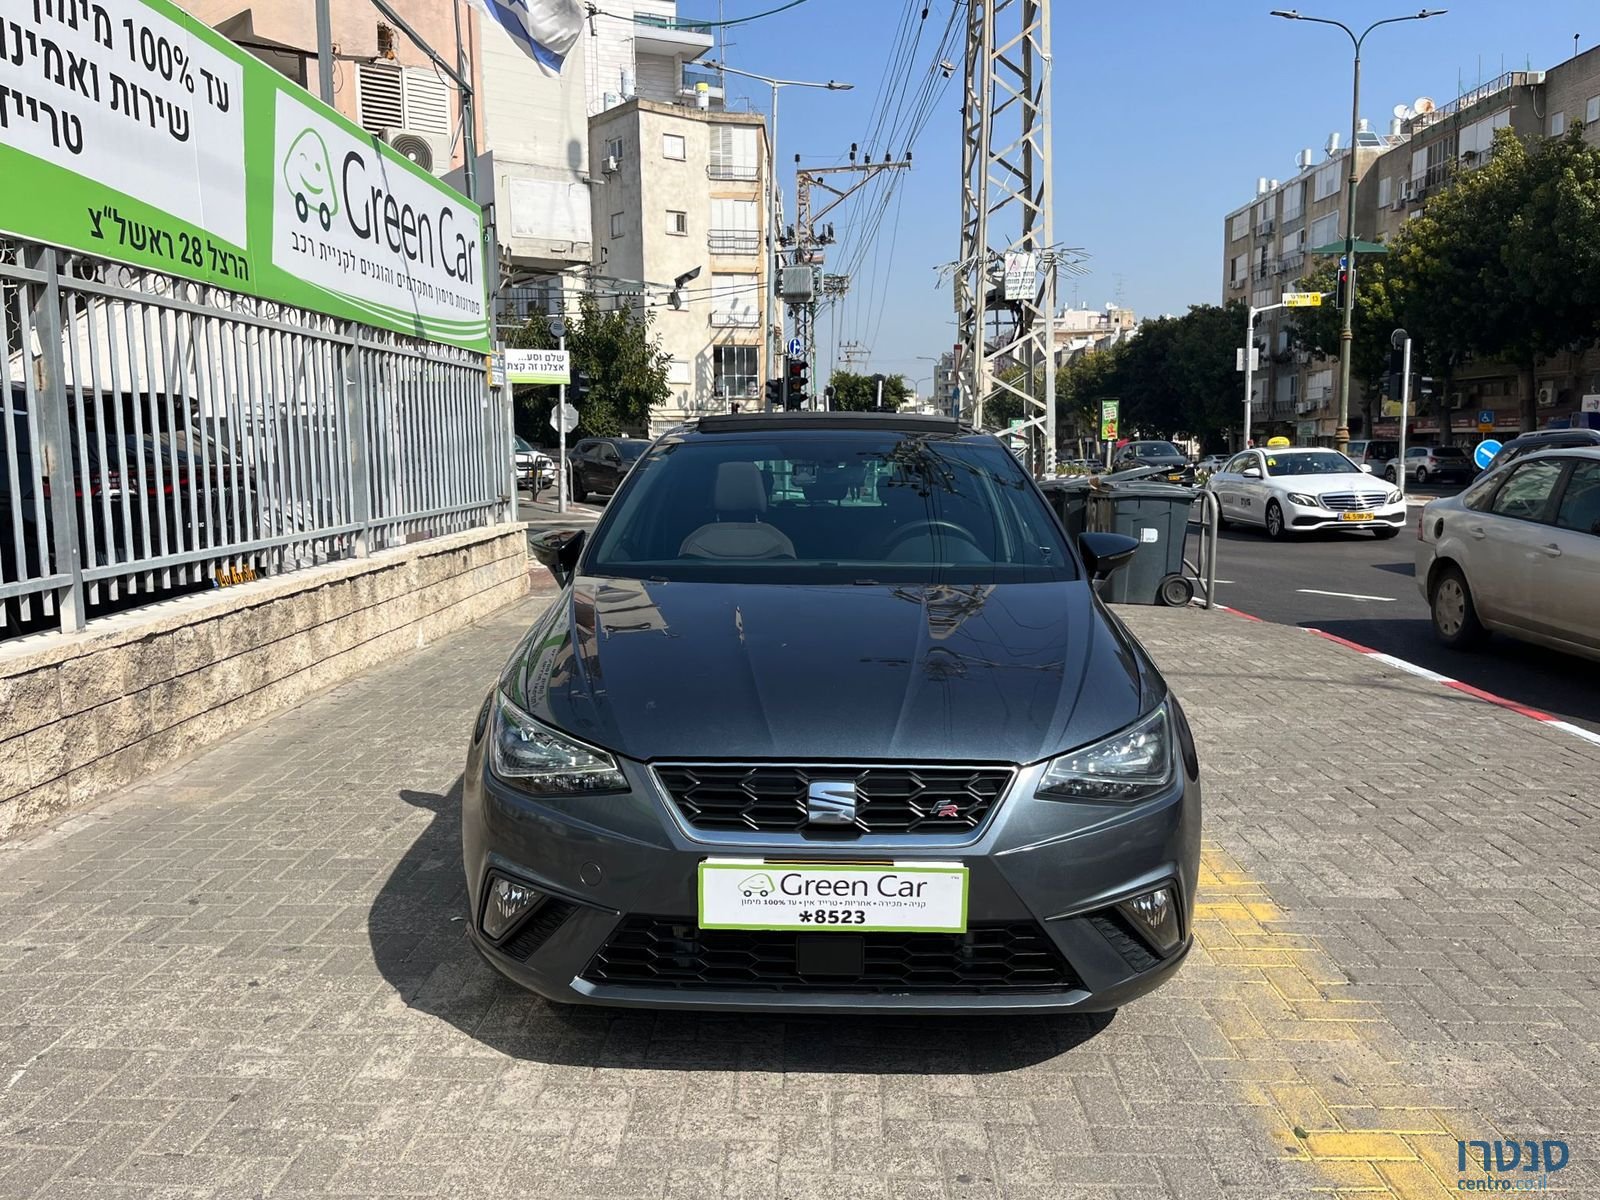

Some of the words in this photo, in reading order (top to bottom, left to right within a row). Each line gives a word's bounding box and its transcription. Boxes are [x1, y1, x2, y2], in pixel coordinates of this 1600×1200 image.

[123, 19, 194, 94] 100%
[200, 68, 229, 113] עד
[110, 72, 190, 142] שירות
[342, 151, 434, 268] Green
[439, 206, 475, 285] Car
[87, 205, 175, 260] ראשל"צ
[291, 231, 315, 257] רכב
[179, 232, 204, 268] 28
[207, 240, 249, 282] הרצל
[319, 242, 356, 274] לקניית
[360, 258, 394, 285] והוגנים
[397, 272, 434, 299] מתקדמים
[435, 286, 454, 306] מימון
[455, 294, 481, 315] פתרונות
[506, 362, 525, 372] קצת
[528, 363, 538, 371] זה
[540, 362, 565, 371] אצלנו
[545, 353, 565, 362] שלם
[930, 799, 959, 817] FR
[780, 873, 868, 897] Green
[877, 874, 928, 898] Car
[741, 899, 761, 907] מימון
[803, 899, 816, 908] אין
[817, 899, 838, 907] טרייד
[878, 900, 902, 908] מכירה
[908, 901, 927, 909] קניה
